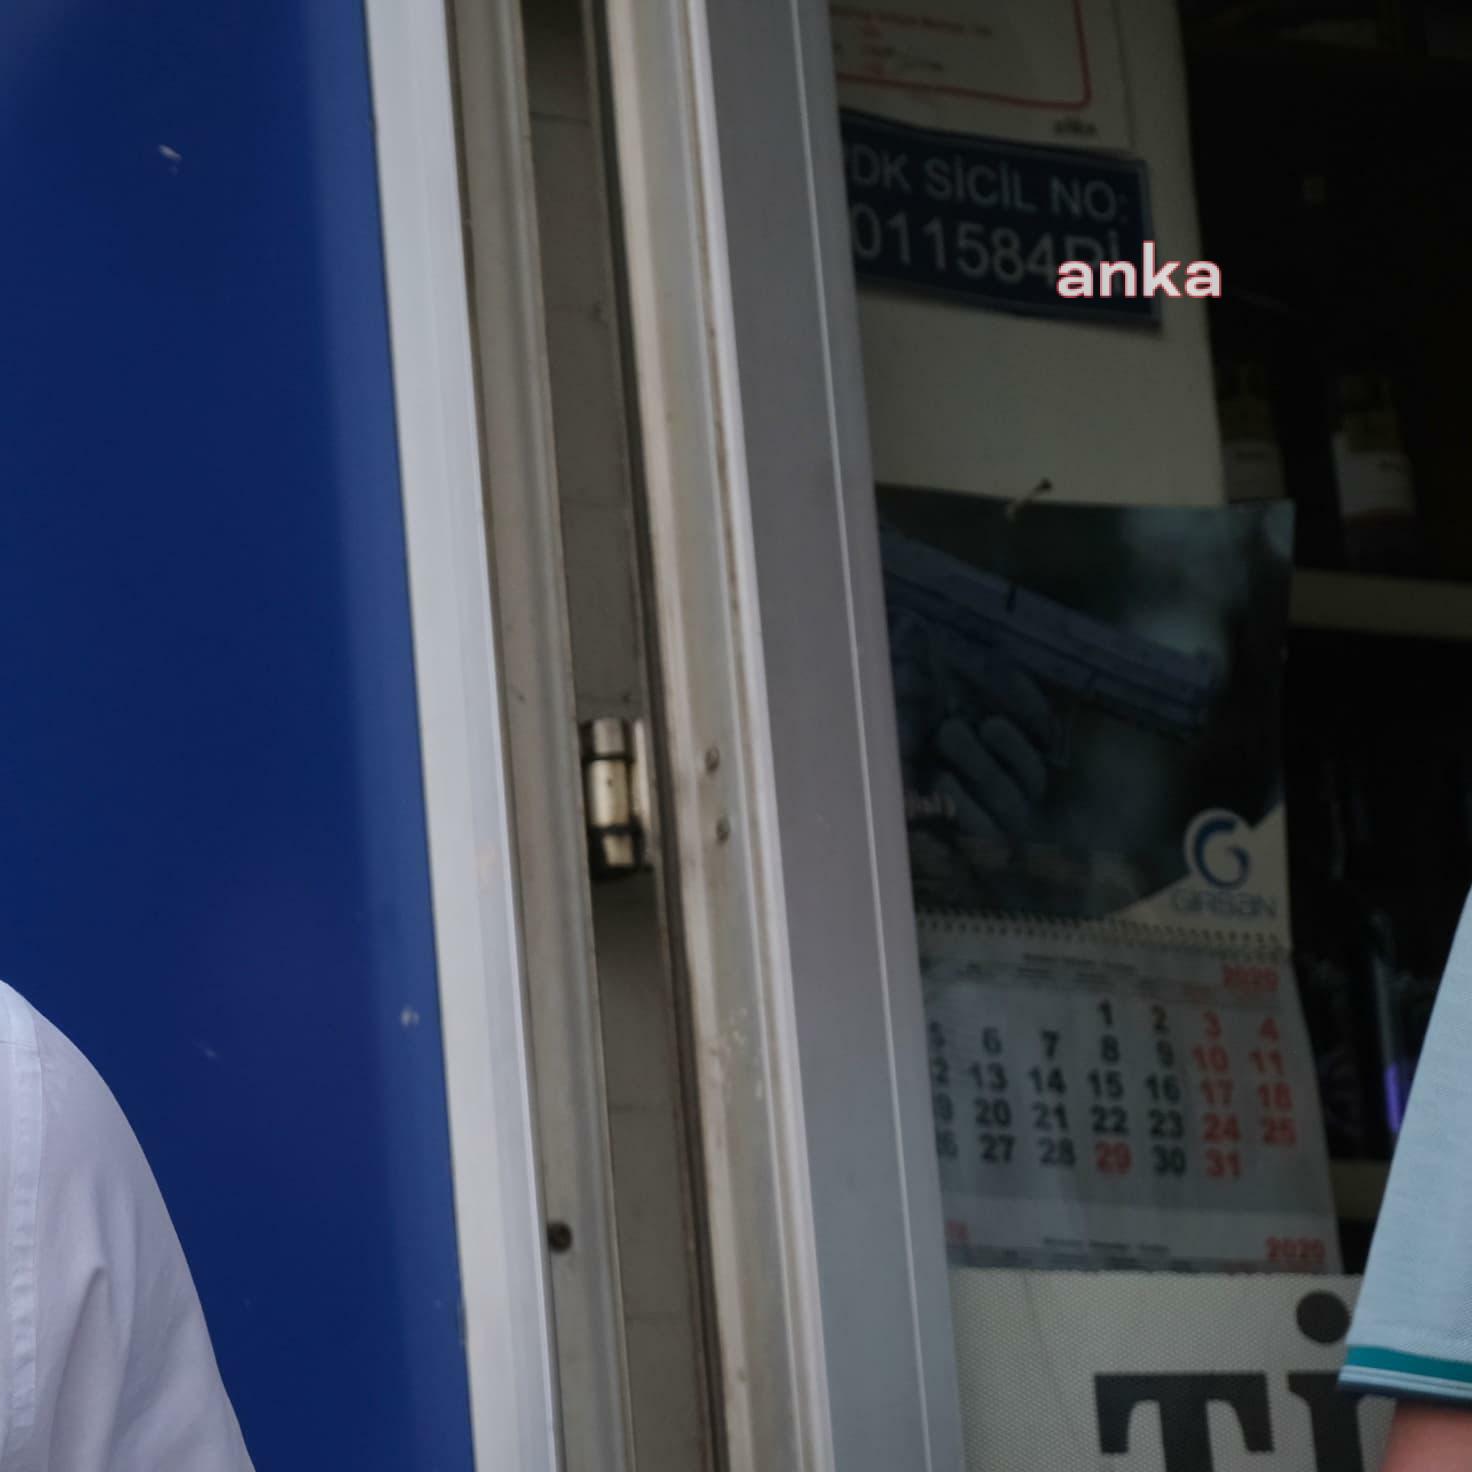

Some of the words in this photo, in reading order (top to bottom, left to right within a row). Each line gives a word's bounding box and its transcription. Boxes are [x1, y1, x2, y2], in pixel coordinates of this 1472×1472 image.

[923, 153, 1038, 212] SİCİL
[1048, 174, 1128, 224] NO:
[1099, 1000, 1113, 1026] 1
[1152, 1006, 1167, 1034] 2
[1204, 1010, 1221, 1039] 3
[1259, 1018, 1277, 1042] 4
[983, 1029, 1001, 1054] 6
[1042, 1031, 1059, 1057] 7
[1193, 1047, 1228, 1072] 10
[1250, 1050, 1284, 1074] 11
[972, 1065, 1007, 1091] 13
[1030, 1068, 1066, 1093] 14
[1089, 1072, 1123, 1099] 15
[1146, 1075, 1180, 1103] 16
[1201, 1079, 1233, 1104] 17
[1258, 1083, 1293, 1108] 18
[975, 1099, 1011, 1126] 20
[1033, 1104, 1068, 1130] 21
[1091, 1107, 1128, 1135] 22
[1149, 1110, 1184, 1140] 23
[1203, 1115, 1240, 1142] 24
[1263, 1118, 1296, 1146] 25
[980, 1136, 1015, 1162] 27
[1040, 1138, 1075, 1165] 28
[1095, 1142, 1130, 1173] 29
[1153, 1147, 1186, 1175] 30
[1206, 1151, 1242, 1176] 31
